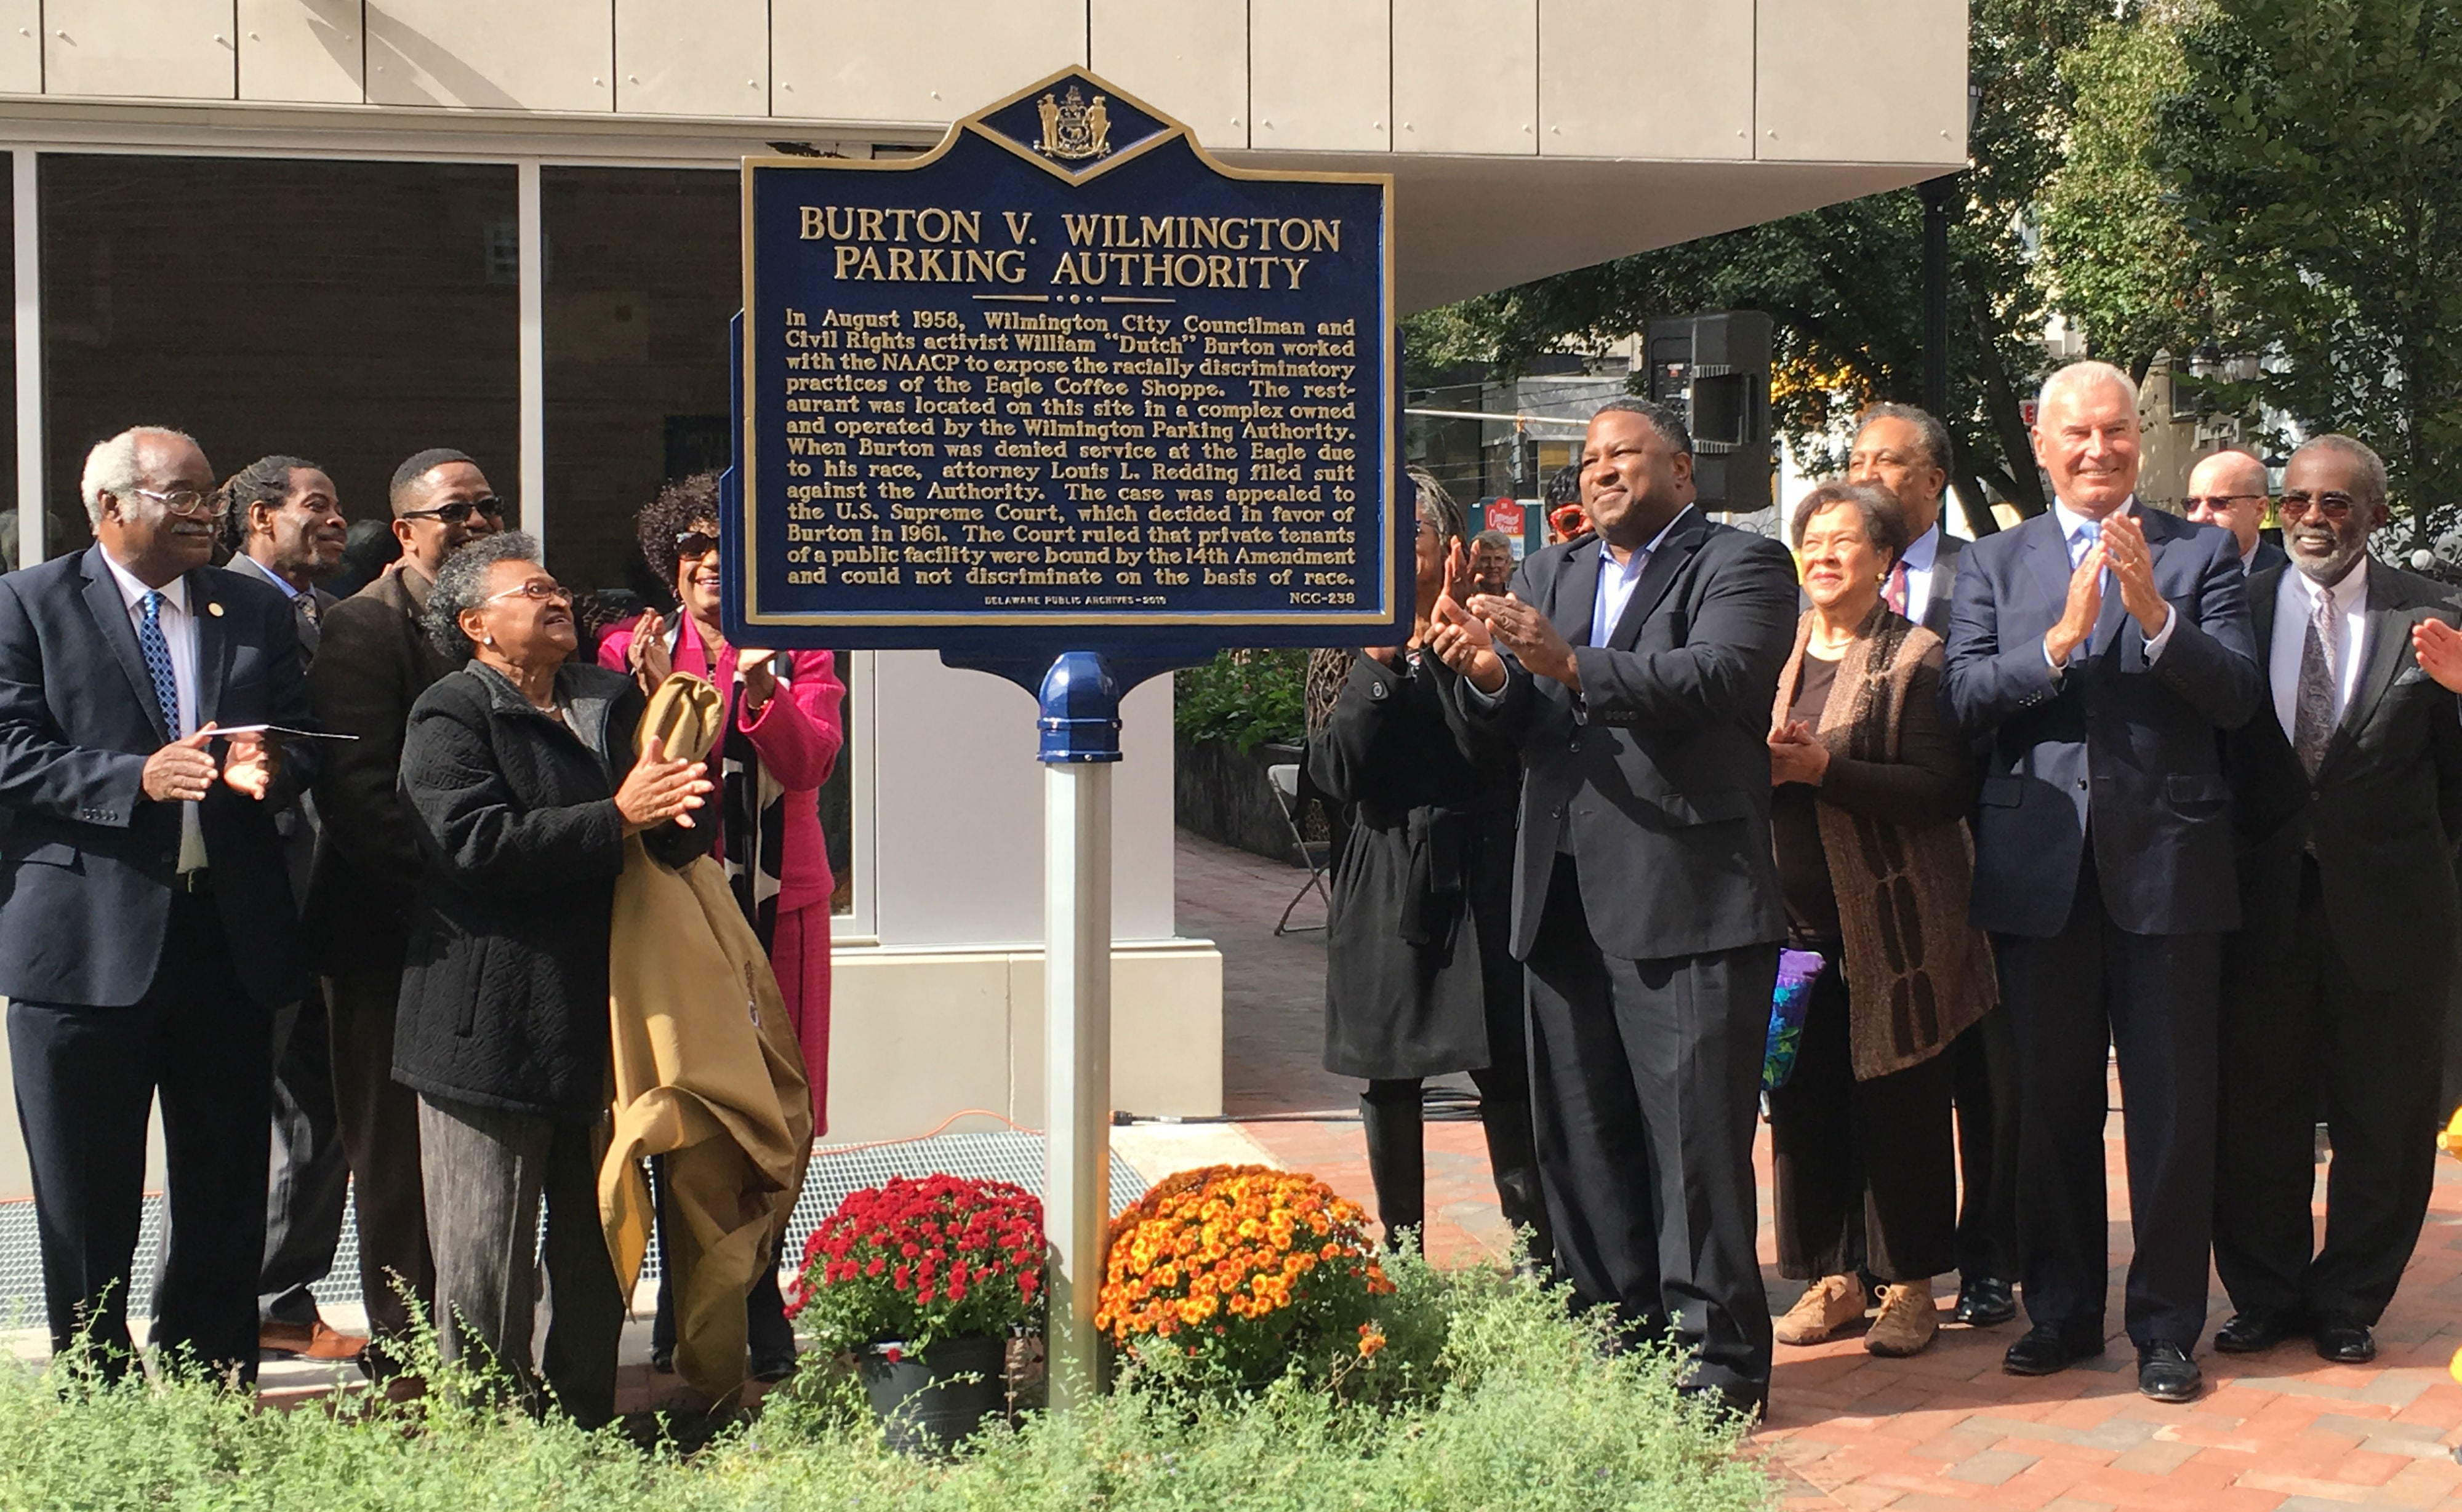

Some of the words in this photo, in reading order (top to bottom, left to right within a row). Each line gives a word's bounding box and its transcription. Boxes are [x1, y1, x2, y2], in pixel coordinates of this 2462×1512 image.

[800, 207, 981, 243] BURTON
[1002, 212, 1036, 244] V.
[1061, 214, 1341, 252] WILMINGTON
[834, 246, 1026, 282] PARKING
[1051, 252, 1309, 289] AUTHORITY
[787, 308, 806, 326] In
[823, 309, 900, 331] August
[913, 311, 965, 332] 1958,
[984, 312, 1107, 335] Wilmington
[1122, 314, 1171, 335] City
[1184, 315, 1305, 335] Councilman
[1318, 319, 1354, 335] and
[785, 330, 838, 348] Civil
[846, 331, 915, 354] Rights
[924, 334, 1008, 350] activist
[1015, 334, 1096, 352] William
[1105, 332, 1196, 353] “Dutch”
[1204, 337, 1275, 355] Burton
[1282, 340, 1355, 356] worked
[787, 353, 835, 370] with
[840, 353, 877, 370] the
[883, 353, 960, 371] NAACP
[964, 355, 988, 372] to
[994, 360, 1069, 377] expose
[1072, 356, 1108, 374] the
[1113, 358, 1194, 378] racially
[1200, 358, 1355, 380] discriminatory
[787, 375, 887, 394] practices
[900, 376, 924, 392] of
[934, 376, 971, 393] the
[985, 376, 1043, 398] Eagle
[1055, 377, 1129, 395] Coffee
[1142, 380, 1225, 401] Shoppe.
[1249, 380, 1290, 397] The
[1304, 382, 1355, 398] rest-
[787, 395, 859, 412] aurant
[868, 400, 905, 413] was
[915, 396, 996, 414] located
[1006, 402, 1032, 415] on
[1041, 398, 1083, 415] this
[1094, 399, 1134, 416] site
[1145, 400, 1166, 417] in
[1176, 405, 1188, 417] a
[1198, 401, 1283, 422] complex
[1290, 402, 1355, 418] owned
[787, 417, 826, 433] and
[835, 418, 935, 438] operated
[944, 418, 972, 438] by
[979, 419, 1016, 435] the
[1023, 419, 1144, 441] Wilmington
[1153, 421, 1233, 443] Parking
[1241, 422, 1355, 442] Authority.
[787, 438, 846, 455] When
[859, 438, 934, 456] Burton
[944, 444, 982, 457] was
[995, 440, 1067, 458] denied
[1080, 442, 1157, 458] service
[1169, 442, 1190, 459] at
[1201, 442, 1238, 459] the
[1251, 442, 1306, 464] Eagle
[1318, 444, 1355, 460] due
[787, 460, 811, 476] to
[824, 460, 857, 476] his
[868, 465, 922, 480] race,
[942, 462, 1040, 481] attorney
[1051, 462, 1109, 479] Louis
[1120, 462, 1140, 479] L.
[1152, 463, 1238, 485] Redding
[1250, 463, 1302, 481] filed
[1314, 465, 1355, 481] suit
[787, 481, 867, 503] against
[878, 482, 915, 498] the
[927, 482, 1045, 502] Authority.
[1065, 484, 1107, 500] The
[1118, 488, 1165, 501] case
[1176, 489, 1213, 501] was
[1226, 485, 1321, 505] appealed
[1333, 486, 1355, 502] to
[787, 503, 825, 519] the
[836, 503, 879, 519] U.S.
[891, 503, 984, 524] Supreme
[995, 503, 1064, 523] Court,
[1077, 505, 1137, 521] which
[1149, 505, 1231, 521] decided
[1241, 505, 1262, 522] in
[1272, 505, 1325, 522] favor
[1333, 506, 1355, 522] of
[788, 524, 863, 542] Burton
[872, 525, 893, 542] in
[901, 525, 948, 542] 1961.
[962, 525, 1005, 542] The
[1013, 525, 1075, 543] Court
[1082, 526, 1140, 543] ruled
[1147, 526, 1192, 543] that
[1198, 526, 1273, 547] private
[1278, 527, 1355, 543] tenants
[788, 546, 811, 562] of
[814, 550, 827, 562] a
[832, 545, 899, 566] public
[904, 546, 986, 565] facility
[990, 551, 1040, 563] were
[1045, 546, 1110, 564] bound
[1116, 547, 1143, 567] by
[1146, 547, 1182, 564] the
[1186, 548, 1229, 564] 14th
[1235, 547, 1355, 564] Amendment
[788, 567, 827, 583] and
[841, 567, 900, 583] could
[915, 568, 952, 584] not
[966, 567, 1102, 584] discriminate
[1117, 572, 1142, 584] on
[1153, 568, 1189, 585] the
[1203, 568, 1256, 585] basis
[1269, 569, 1293, 585] of
[1304, 572, 1355, 585] race.
[985, 596, 1040, 604] DELAWARE
[1045, 596, 1081, 604] PUBLIC
[1290, 593, 1355, 604] NCC-238
